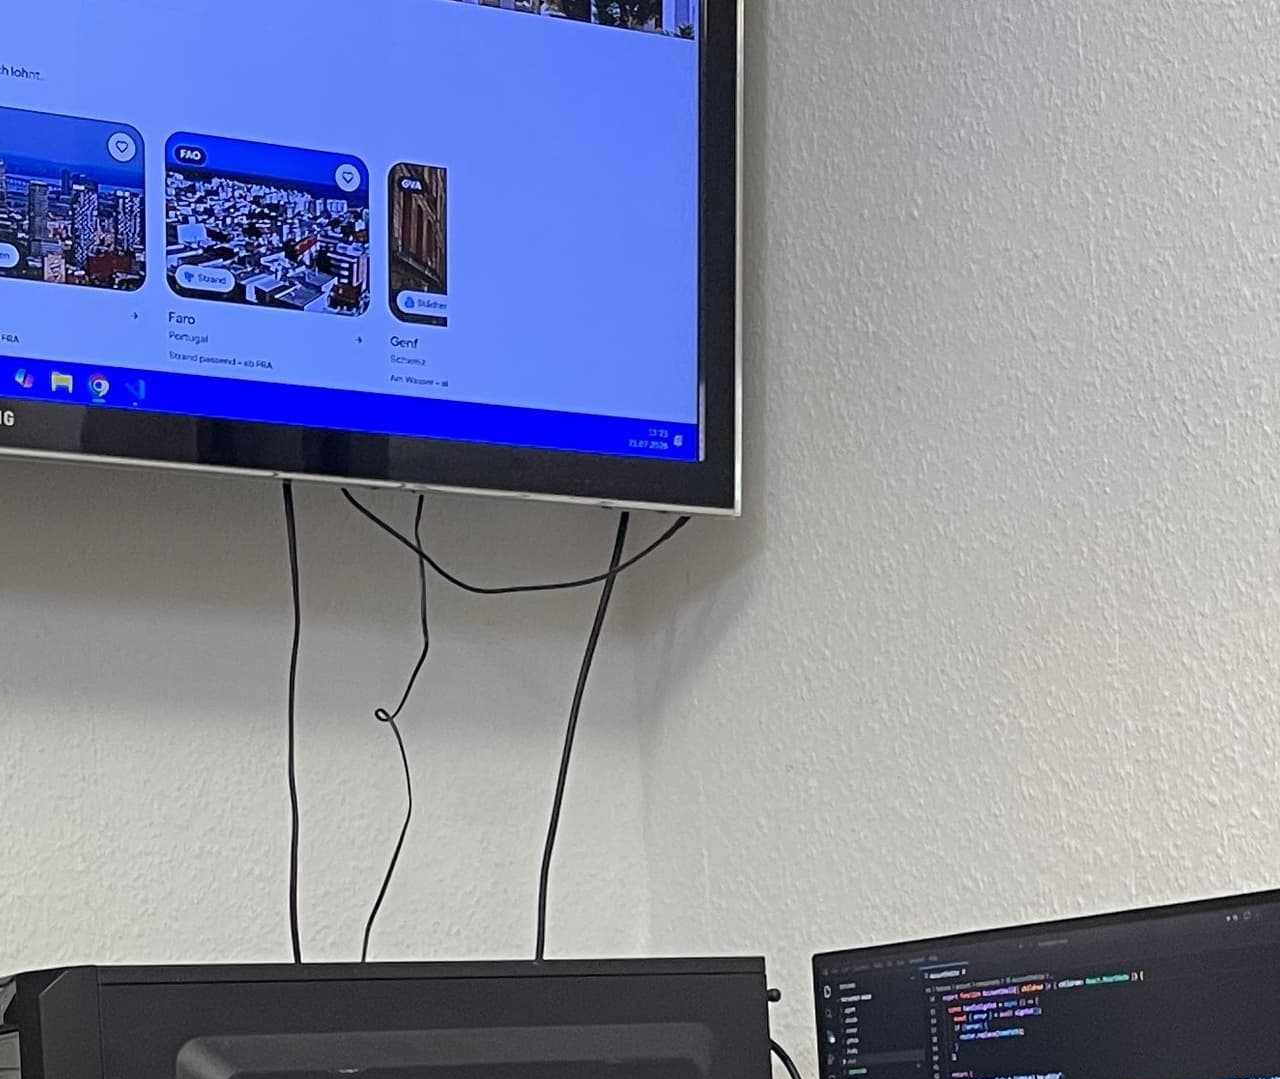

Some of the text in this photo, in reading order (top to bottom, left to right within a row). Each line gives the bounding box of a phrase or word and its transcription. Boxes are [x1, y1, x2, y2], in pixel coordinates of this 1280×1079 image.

[179, 149, 202, 161] FAO
[197, 273, 227, 286] Strand
[168, 312, 196, 325] Faro
[2, 334, 20, 344] FRA
[169, 331, 209, 344] Portugal
[390, 336, 419, 349] Genf
[169, 351, 198, 363] Strand
[199, 354, 237, 367] passend
[256, 360, 273, 370] FRA
